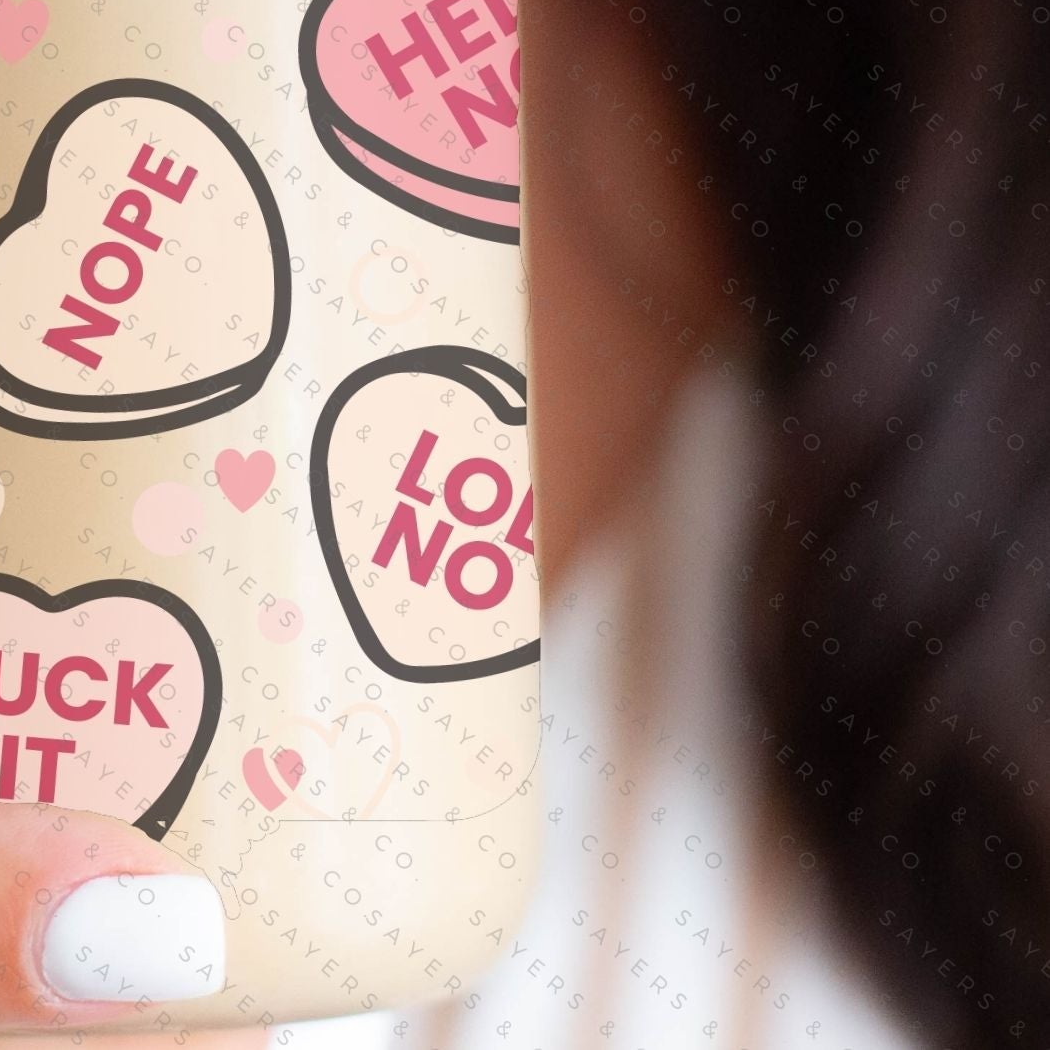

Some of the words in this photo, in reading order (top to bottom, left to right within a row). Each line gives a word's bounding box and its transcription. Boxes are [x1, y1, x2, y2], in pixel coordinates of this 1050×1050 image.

[441, 48, 520, 150] N
[42, 143, 198, 371] NOPE
[371, 501, 514, 610] NO
